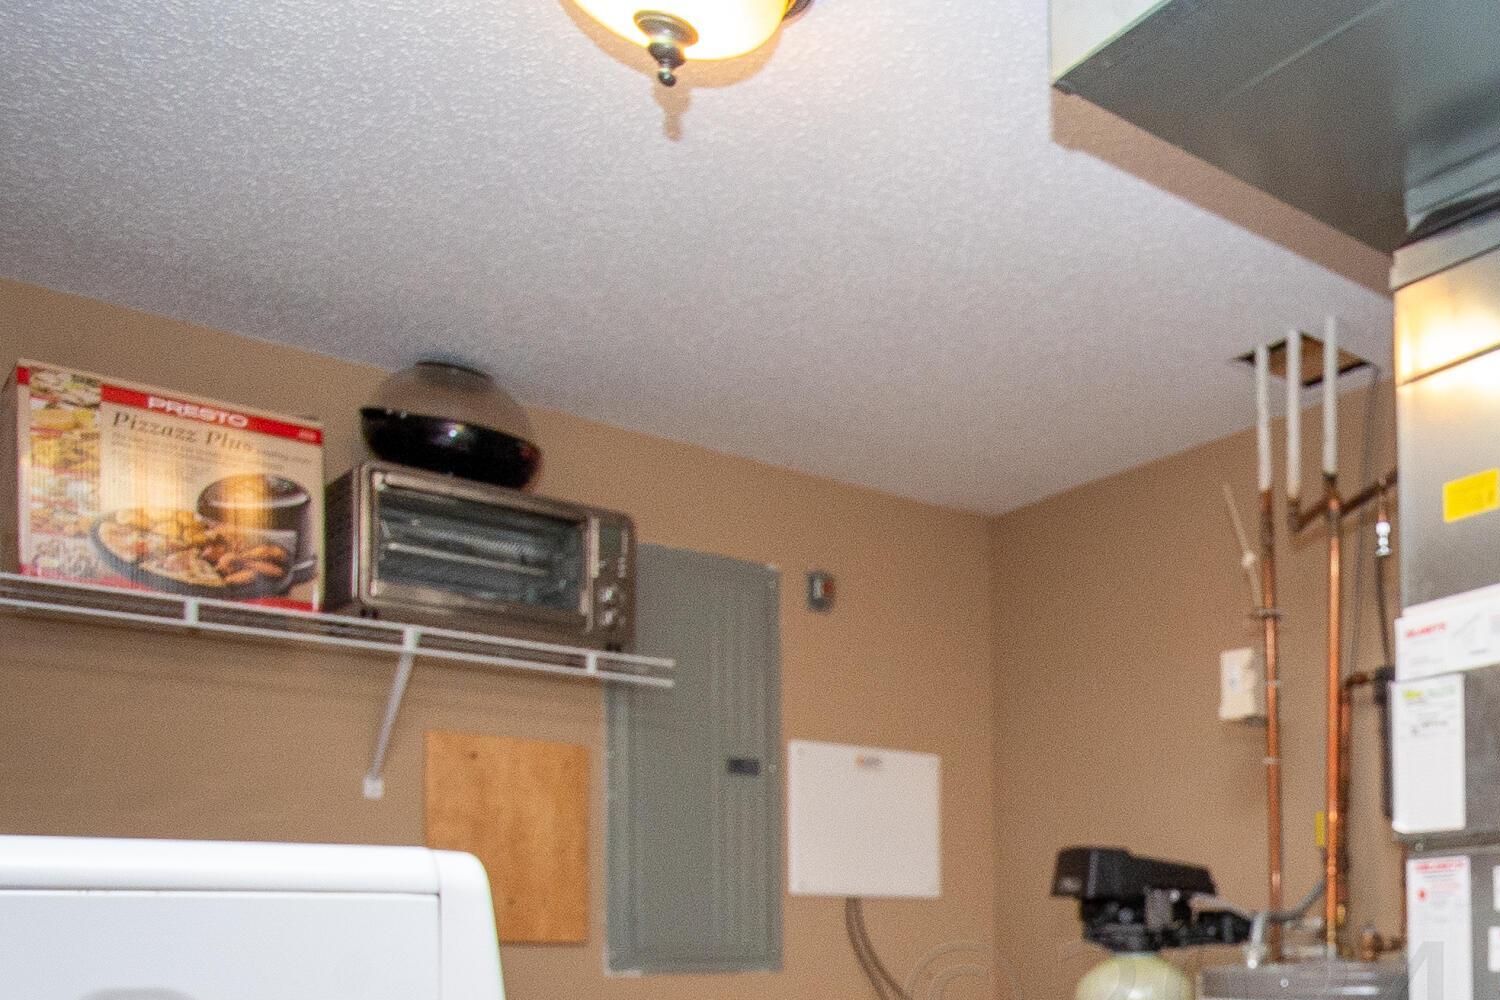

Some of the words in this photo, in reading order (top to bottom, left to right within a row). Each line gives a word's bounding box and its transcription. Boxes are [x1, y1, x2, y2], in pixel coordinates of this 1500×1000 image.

[113, 411, 199, 444] Pizzazz
[207, 429, 253, 451] Plus
[147, 395, 249, 430] PRESTO
